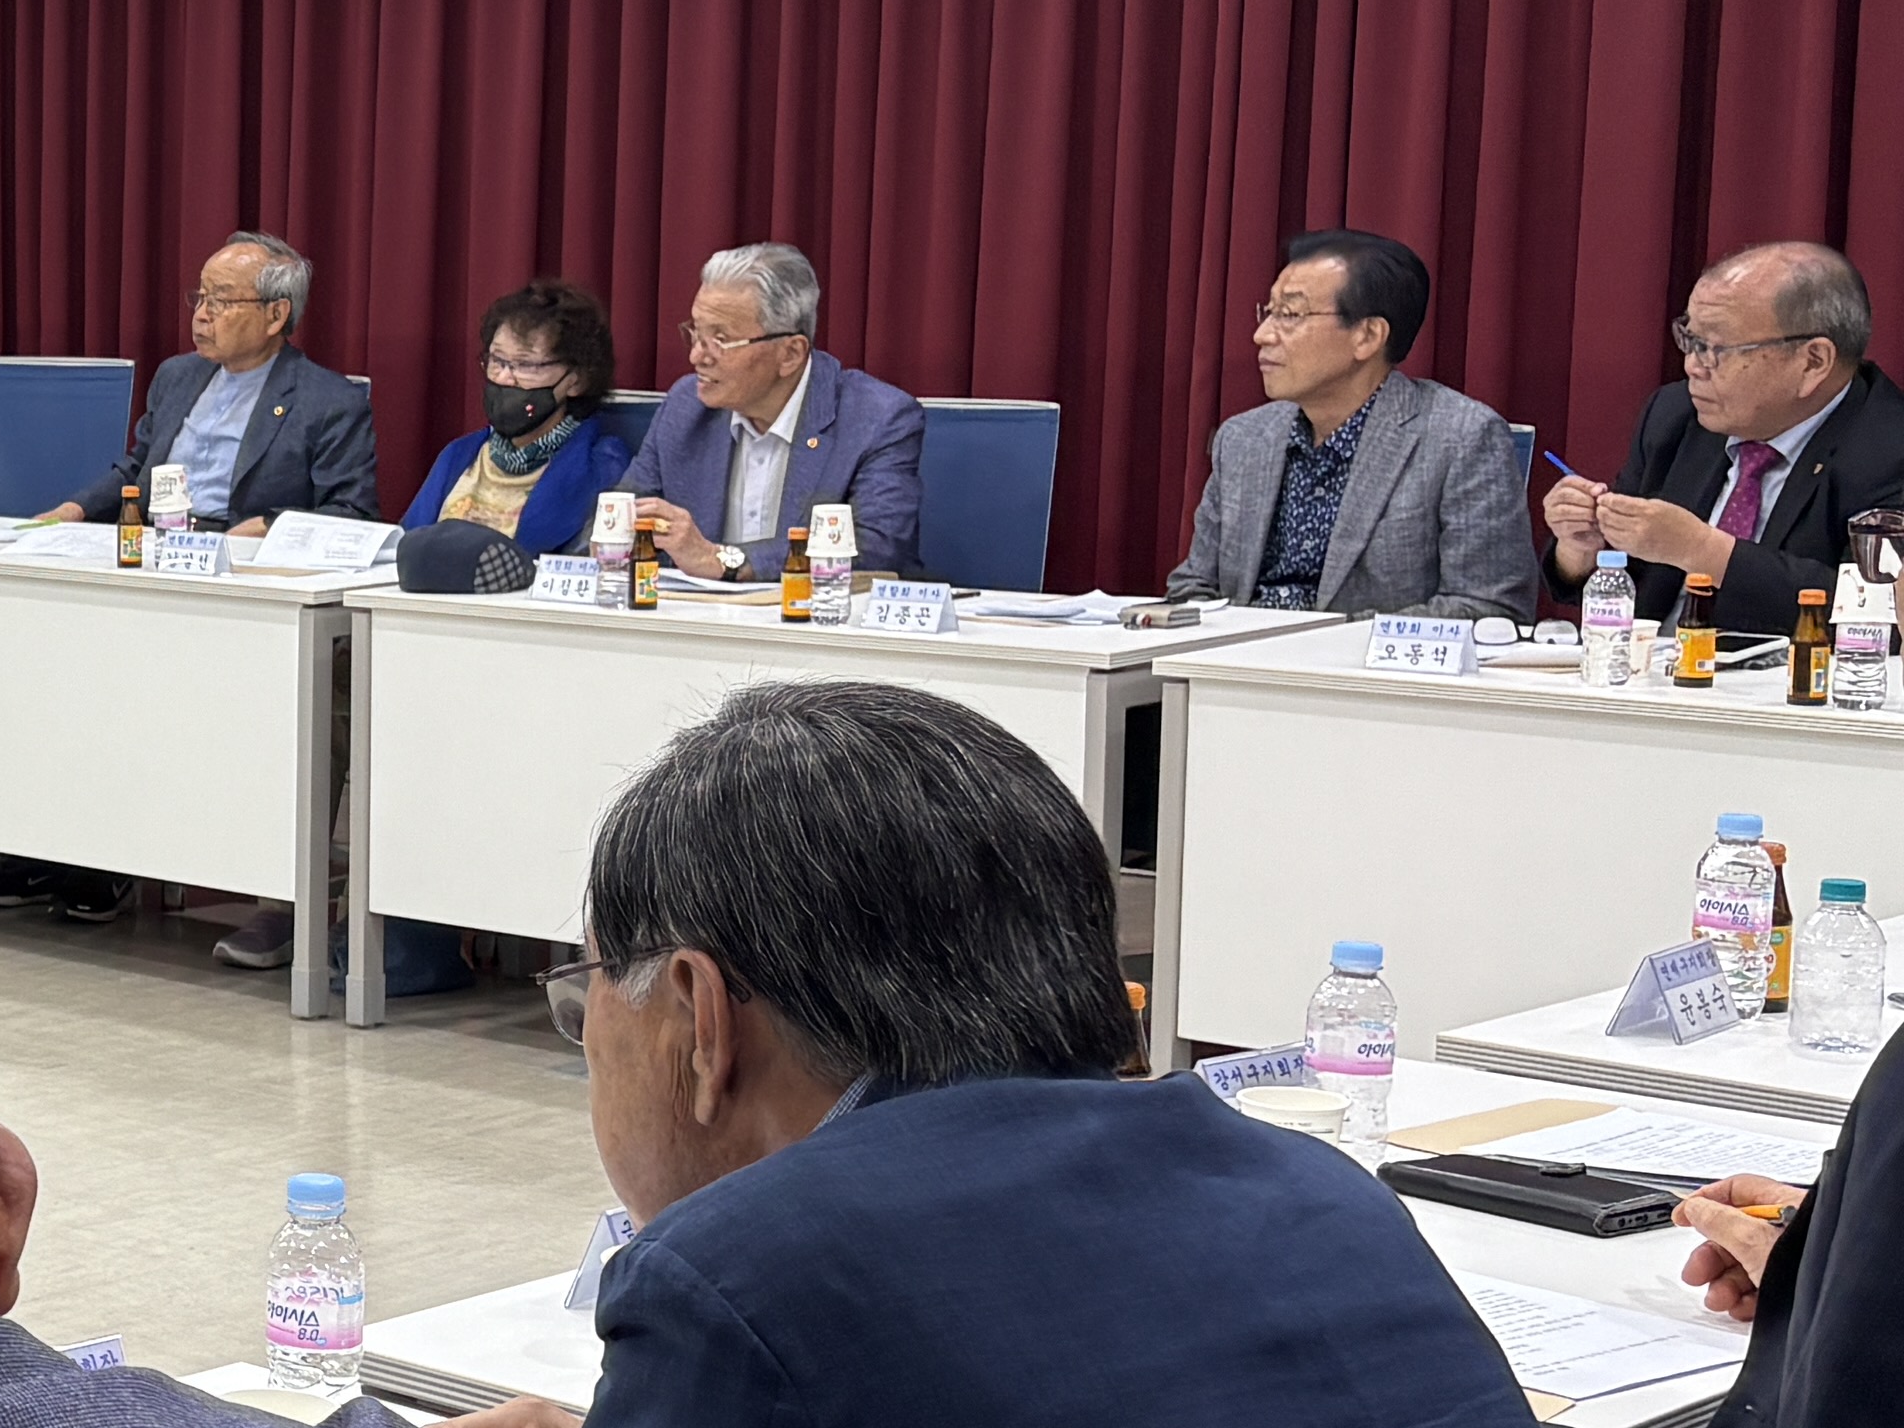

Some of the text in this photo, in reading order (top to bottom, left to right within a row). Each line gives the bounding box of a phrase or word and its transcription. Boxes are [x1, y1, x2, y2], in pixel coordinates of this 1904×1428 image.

[877, 584, 940, 599] 연합회 이사
[1379, 620, 1461, 637] 연합회 이사
[1378, 642, 1448, 667] 오동석
[297, 1327, 320, 1342] 8.0
